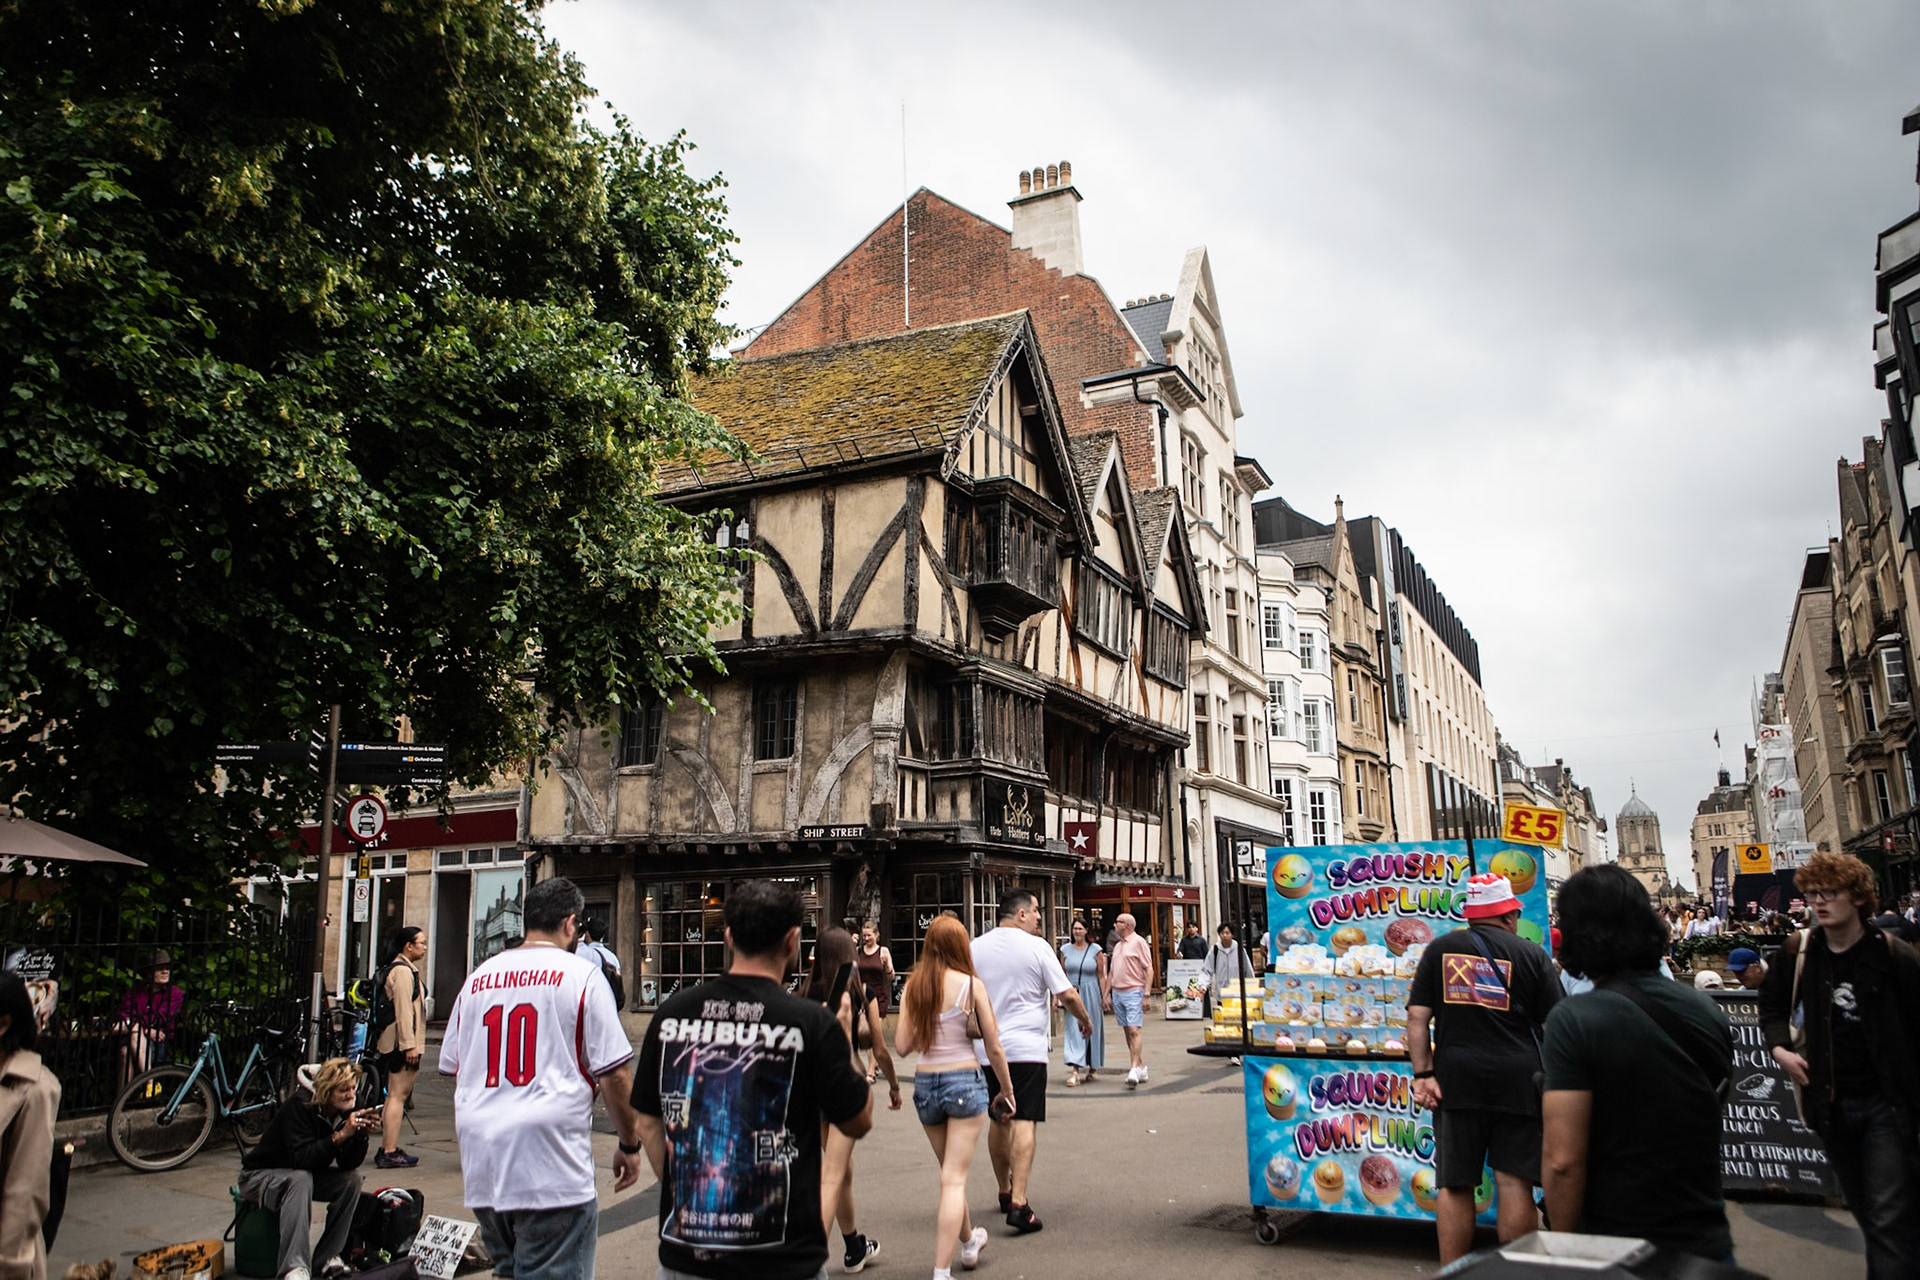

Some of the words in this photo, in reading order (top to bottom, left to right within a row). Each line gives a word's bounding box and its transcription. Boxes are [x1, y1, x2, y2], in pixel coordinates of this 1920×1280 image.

[803, 828, 825, 838] SHIP
[830, 827, 864, 838] STREET
[1008, 826, 1030, 840] Hatters
[1510, 809, 1558, 840] £5
[1328, 853, 1469, 888] SQUISHY
[471, 969, 564, 995] BELLINGHAM
[658, 1018, 804, 1052] SHIBUYA
[483, 1003, 538, 1088] 10
[1723, 1103, 1780, 1122] LICIOUS
[1722, 1118, 1764, 1134] LUNCH
[754, 1128, 800, 1165] 日本
[1750, 1144, 1796, 1161] BRITISH
[1758, 1162, 1790, 1179] HERE
[426, 1217, 448, 1232] THANK
[448, 1222, 462, 1235] YOU
[430, 1232, 449, 1245] HELP
